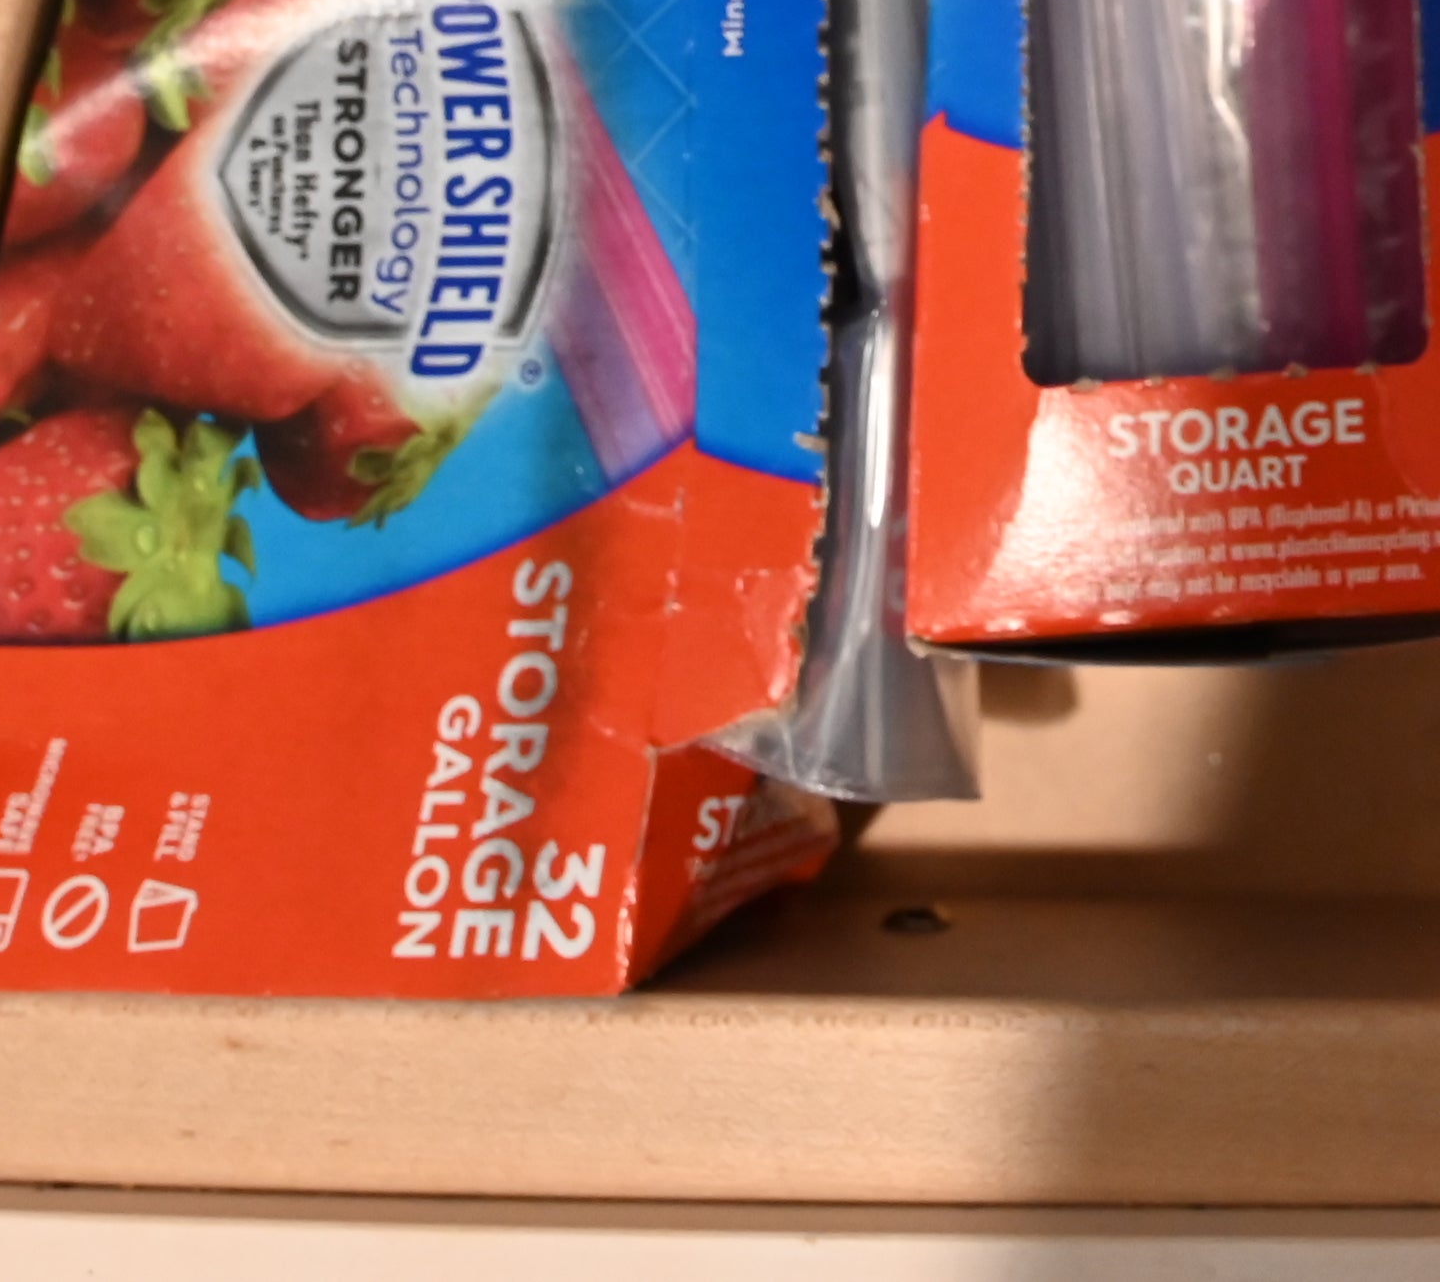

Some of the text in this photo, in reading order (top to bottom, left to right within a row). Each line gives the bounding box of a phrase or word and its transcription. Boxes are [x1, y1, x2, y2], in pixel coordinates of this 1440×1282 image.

[294, 101, 320, 163] Than
[328, 40, 368, 303] STRONGER
[371, 30, 430, 314] Technology
[410, 175, 513, 376] SHIELD
[1108, 400, 1365, 458] STORAGE
[1169, 455, 1308, 495] QUART
[450, 558, 571, 959] STORAGE
[92, 805, 125, 854] BPA
[153, 790, 190, 862] & FILL
[175, 793, 211, 861] STAND
[391, 695, 481, 958] GALLON
[523, 842, 605, 961] 32
